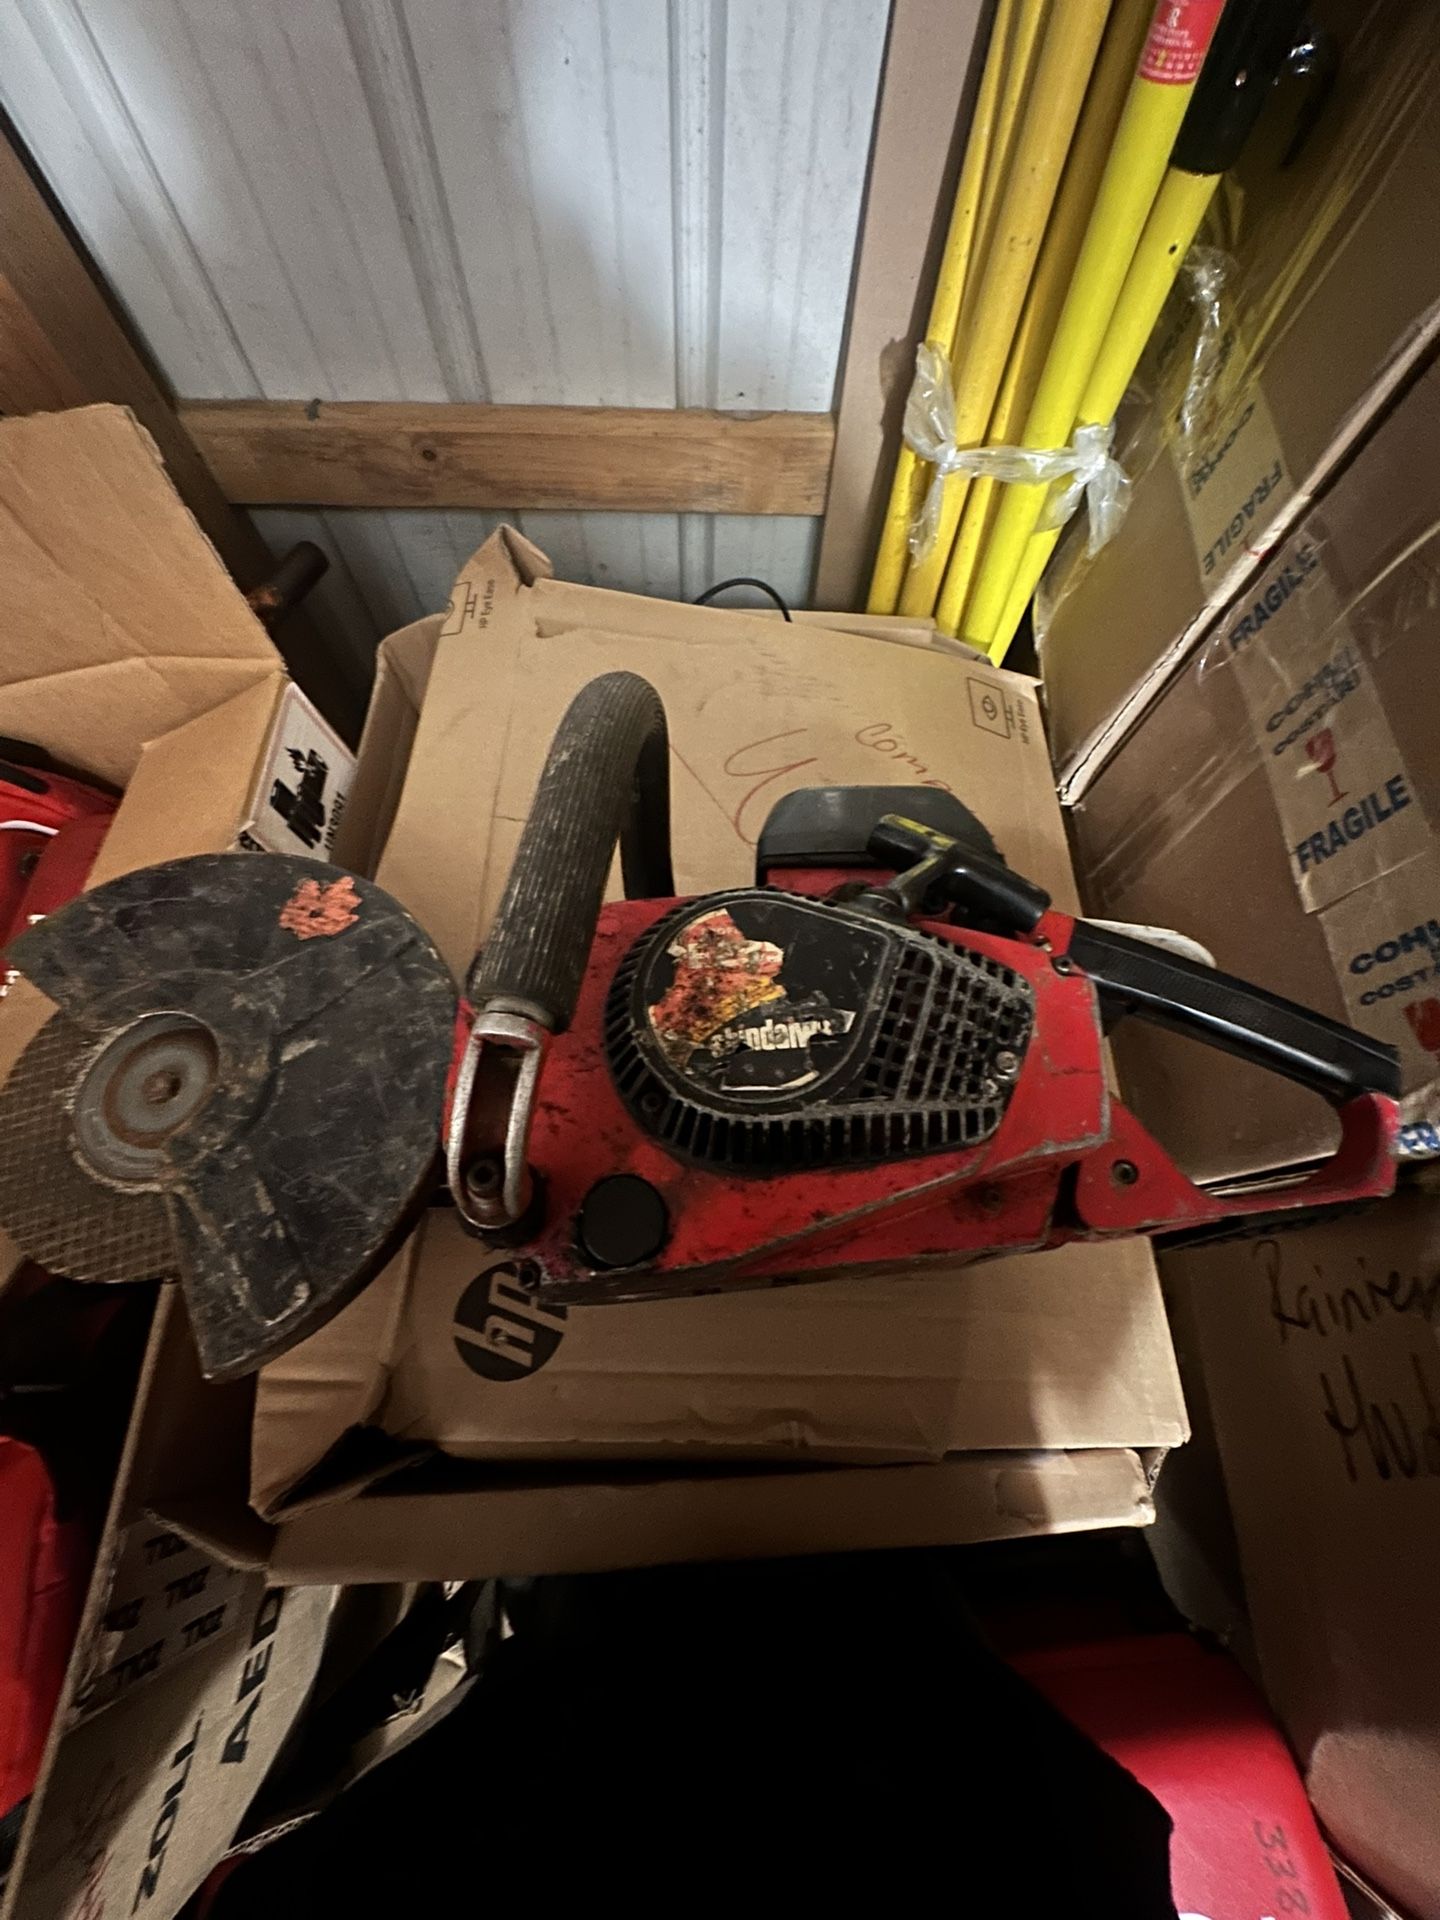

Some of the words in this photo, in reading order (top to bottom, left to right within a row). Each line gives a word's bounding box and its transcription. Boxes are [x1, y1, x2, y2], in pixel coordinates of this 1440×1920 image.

[1203, 460, 1283, 574] FRAGILE
[1228, 543, 1320, 653] FRAGILE
[1294, 774, 1411, 873] FRAGILE
[219, 1589, 284, 1764] AED
[132, 1714, 204, 1914] ZOLL
